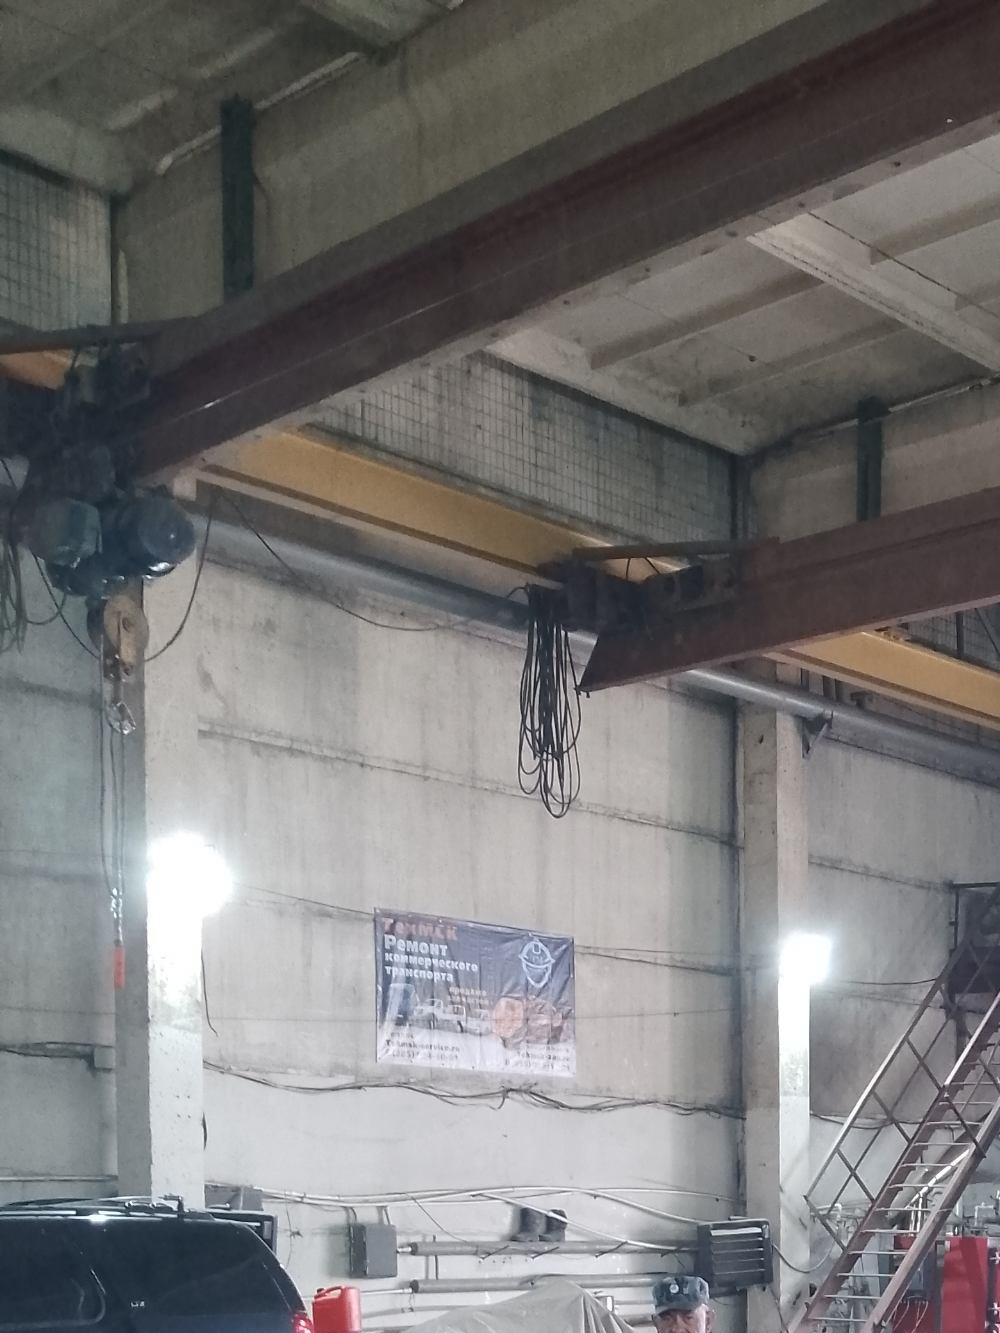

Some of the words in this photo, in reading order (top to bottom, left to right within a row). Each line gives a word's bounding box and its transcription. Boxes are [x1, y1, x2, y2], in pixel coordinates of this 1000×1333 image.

[384, 934, 448, 957] Ремонт
[384, 953, 479, 973] коммерческого
[384, 966, 454, 984] транспорта
